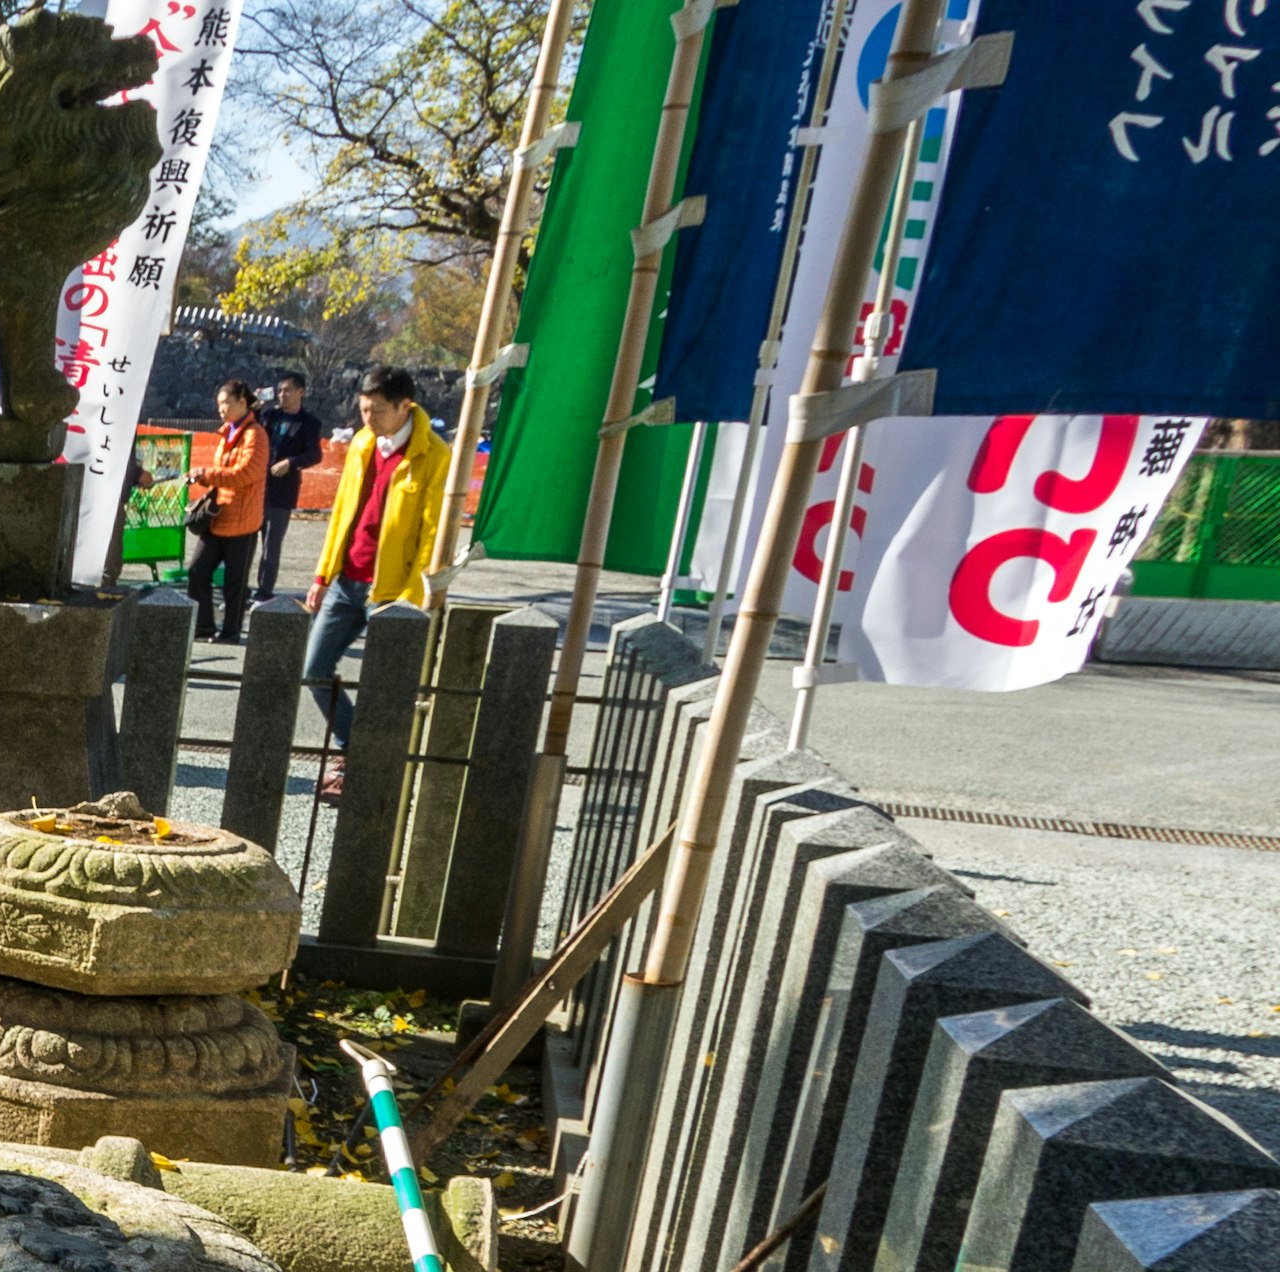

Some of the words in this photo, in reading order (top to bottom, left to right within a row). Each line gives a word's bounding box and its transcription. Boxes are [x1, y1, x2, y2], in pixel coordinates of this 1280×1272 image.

[127, 8, 231, 291] 熊本復興祈願
[89, 355, 131, 475] せいしょこ
